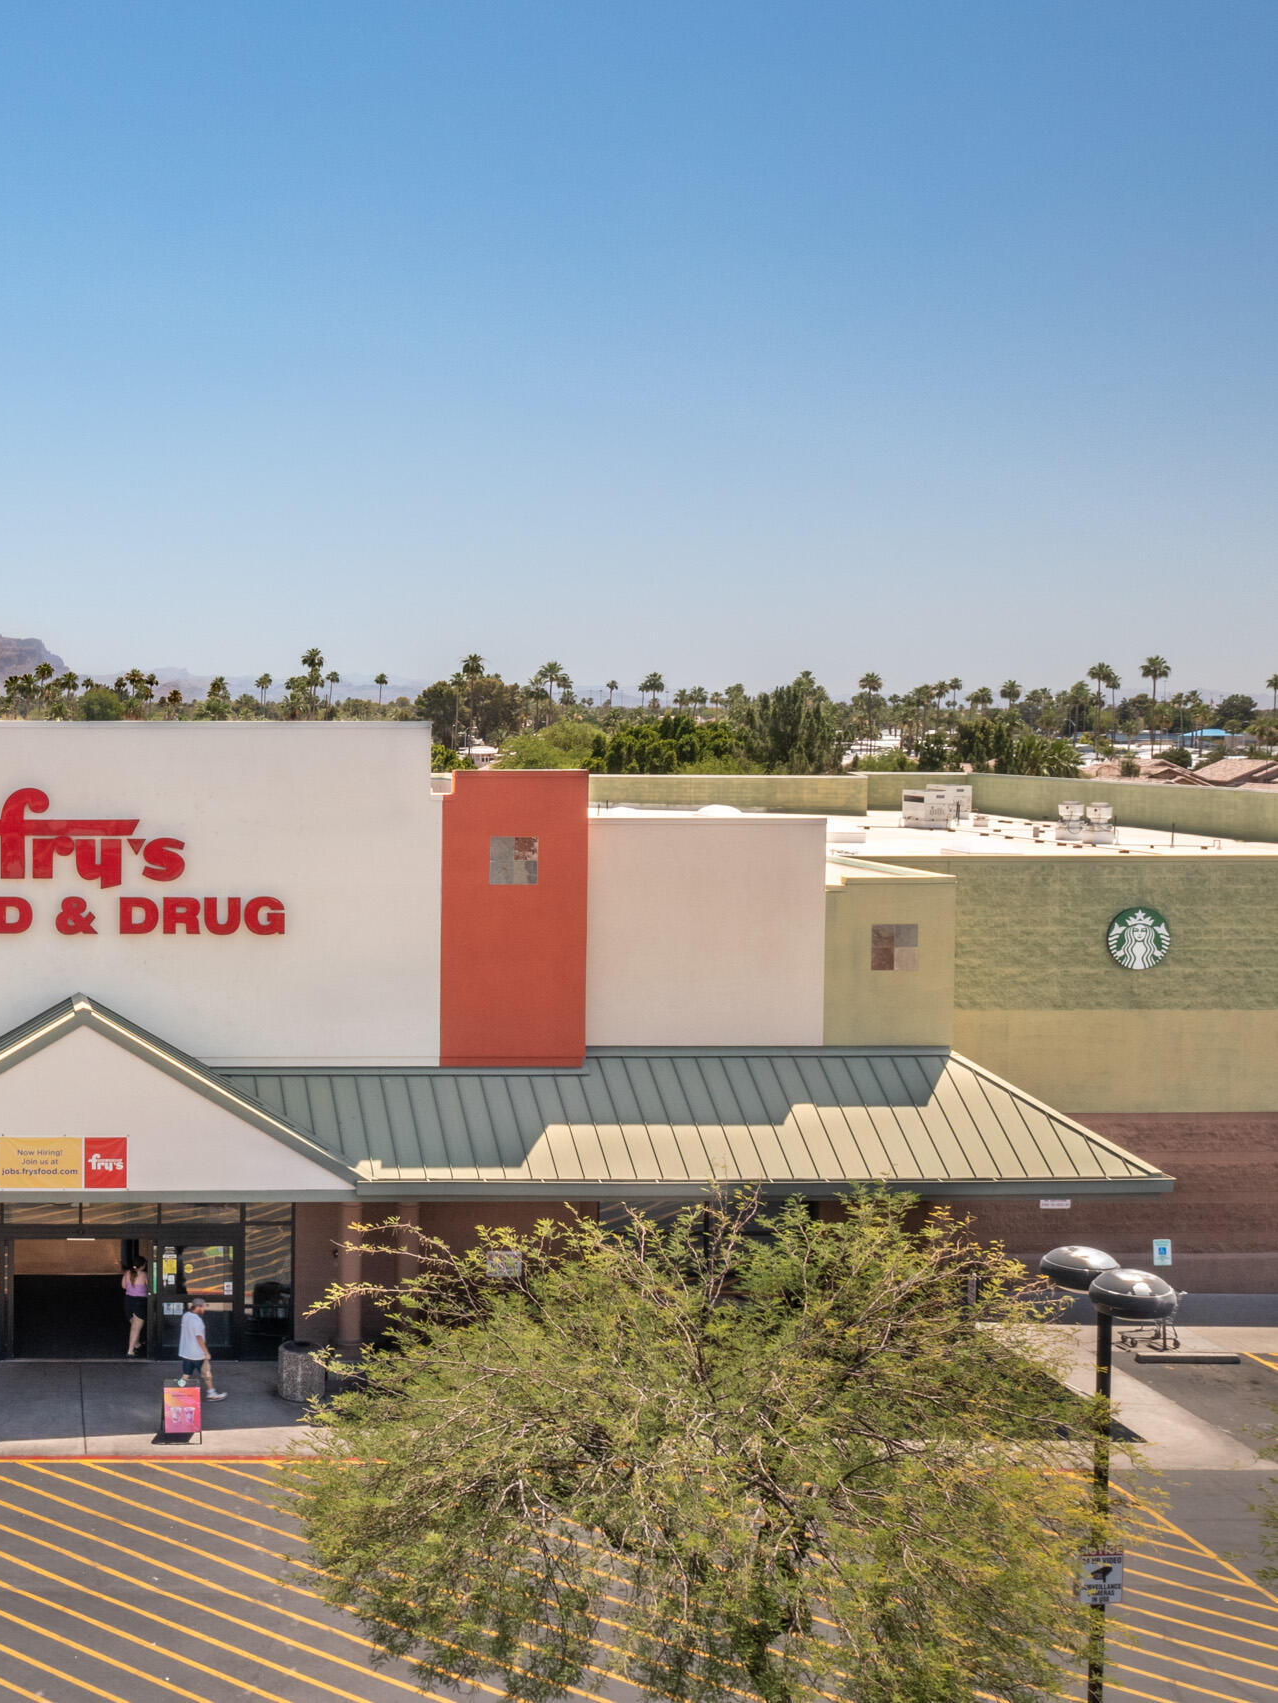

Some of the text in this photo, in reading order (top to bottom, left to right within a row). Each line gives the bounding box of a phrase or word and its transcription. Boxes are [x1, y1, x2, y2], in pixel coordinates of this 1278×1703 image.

[55, 896, 98, 935] &
[119, 896, 286, 935] DRUG
[17, 1149, 63, 1158] Now Hiring!
[21, 1158, 37, 1166] Join
[88, 1153, 124, 1172] fry's
[1, 1167, 79, 1177] jobs.frysfood.com
